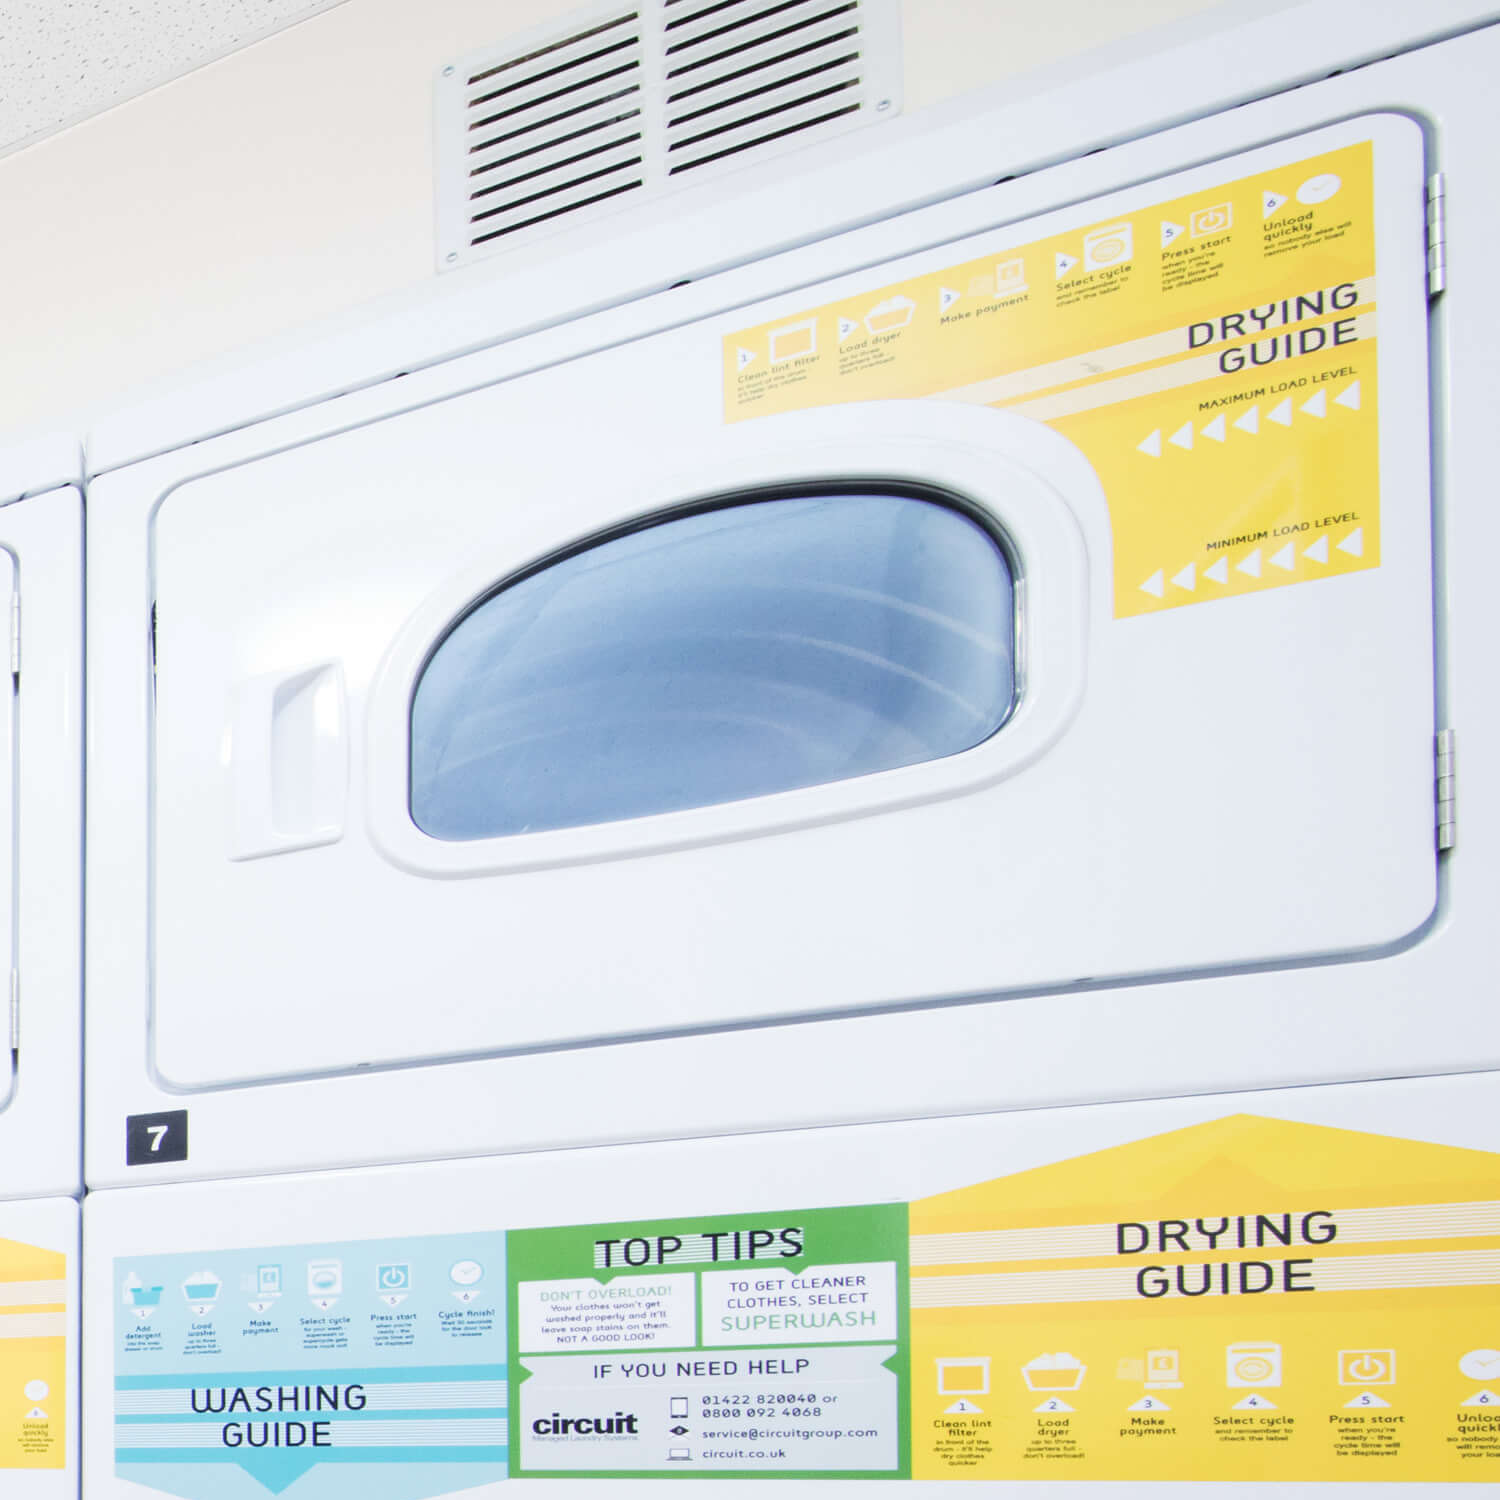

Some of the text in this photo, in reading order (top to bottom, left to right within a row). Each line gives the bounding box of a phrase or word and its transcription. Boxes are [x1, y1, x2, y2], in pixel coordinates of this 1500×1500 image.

[1188, 283, 1359, 349] DRYING
[1219, 316, 1358, 374] GUIDE
[1199, 366, 1357, 411] MAXIMUM LOAD LEVEL
[1207, 512, 1359, 551] MINIMUM LOAD LEVEL
[147, 1125, 168, 1151] 7
[1117, 1210, 1337, 1255] DRYING
[595, 1228, 803, 1268] TOP TIPS
[730, 1276, 866, 1292] TO GET CLEANER
[1137, 1259, 1316, 1299] GUIDE
[540, 1286, 672, 1301] DON'T OVERLOAD!
[727, 1292, 868, 1309] CLOTHES, SELECT
[722, 1311, 875, 1332] SUPERWASH
[594, 1359, 810, 1378] IF YOU NEED HELP
[191, 1385, 366, 1412] WASHING
[702, 1394, 838, 1405] 01422 820040 or
[533, 1412, 638, 1435] circuit
[702, 1407, 821, 1418] 0800 092 4068
[222, 1421, 332, 1447] GUIDE
[702, 1427, 878, 1441] service@circuitgroup.com
[702, 1449, 785, 1459] circuit.co.uk
